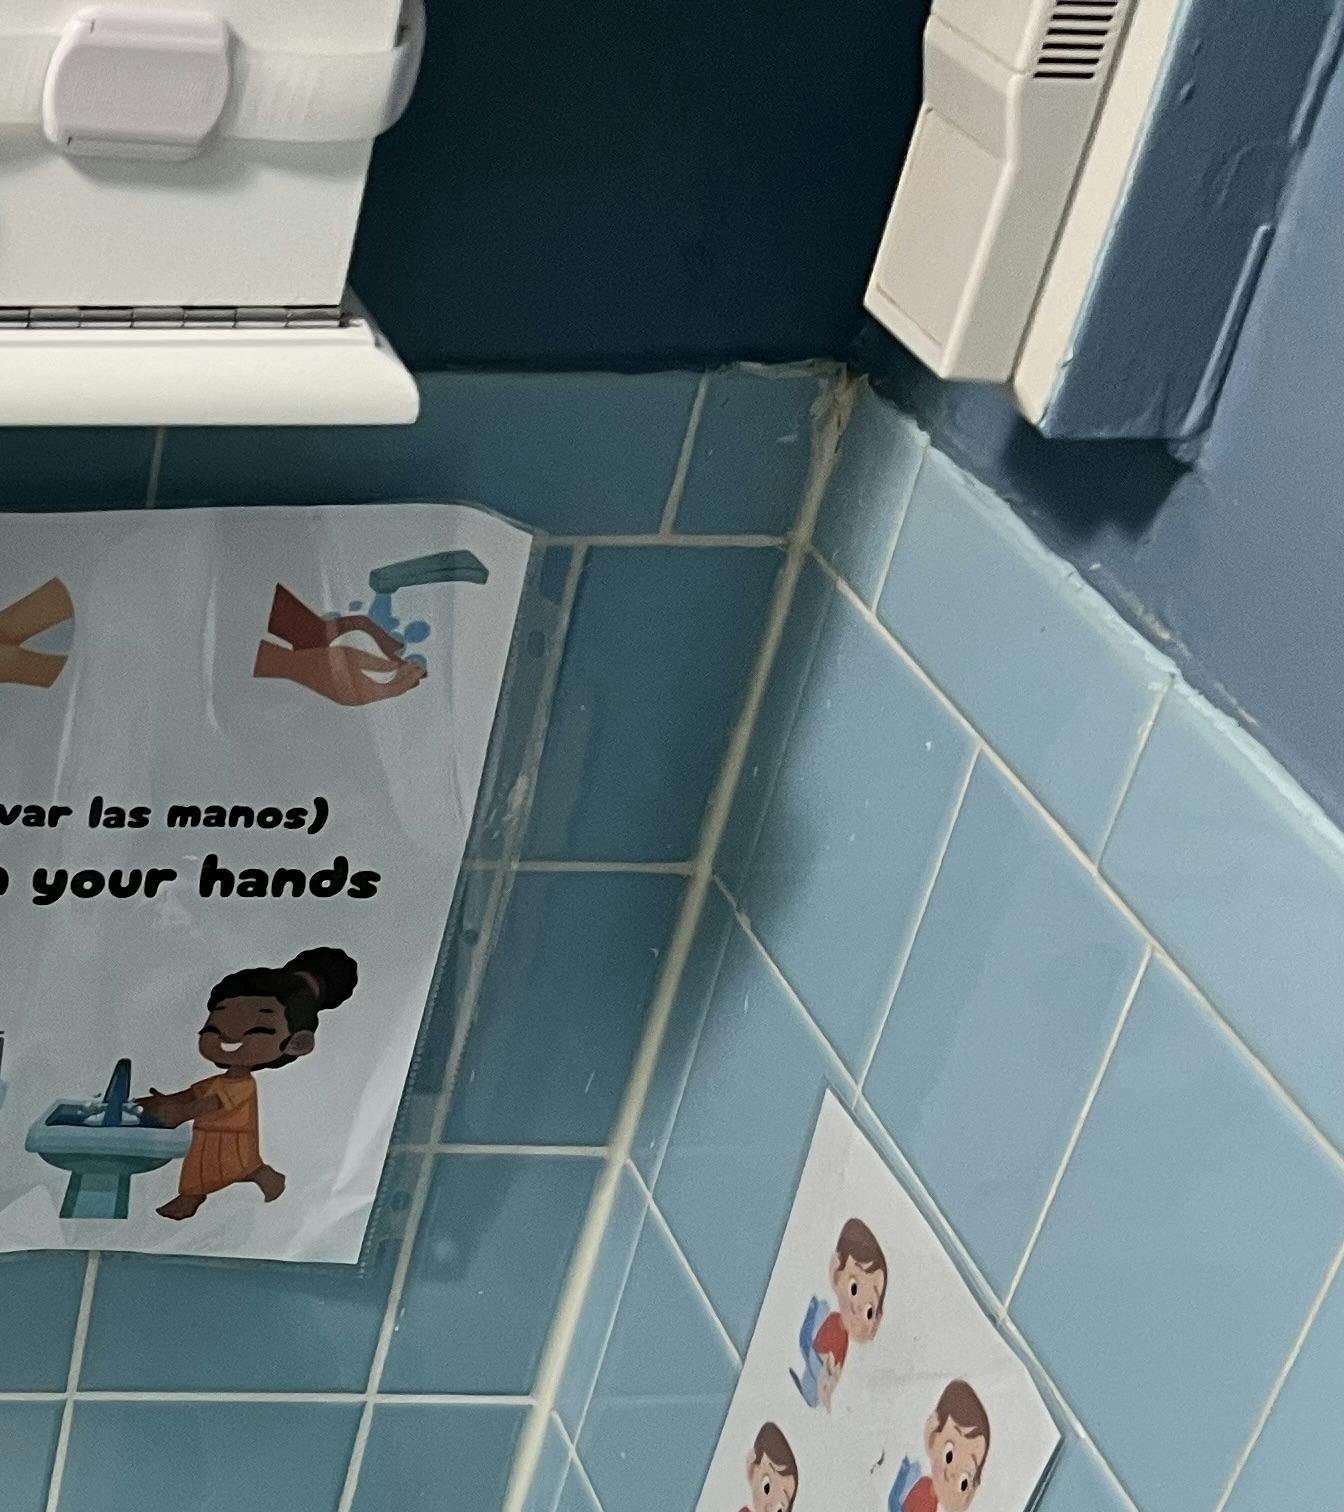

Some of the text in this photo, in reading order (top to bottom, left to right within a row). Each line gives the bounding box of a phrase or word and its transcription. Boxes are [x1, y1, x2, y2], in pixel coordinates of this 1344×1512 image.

[88, 795, 152, 830] las
[166, 796, 330, 836] manos)
[32, 867, 179, 907] your
[198, 853, 382, 900] hands
